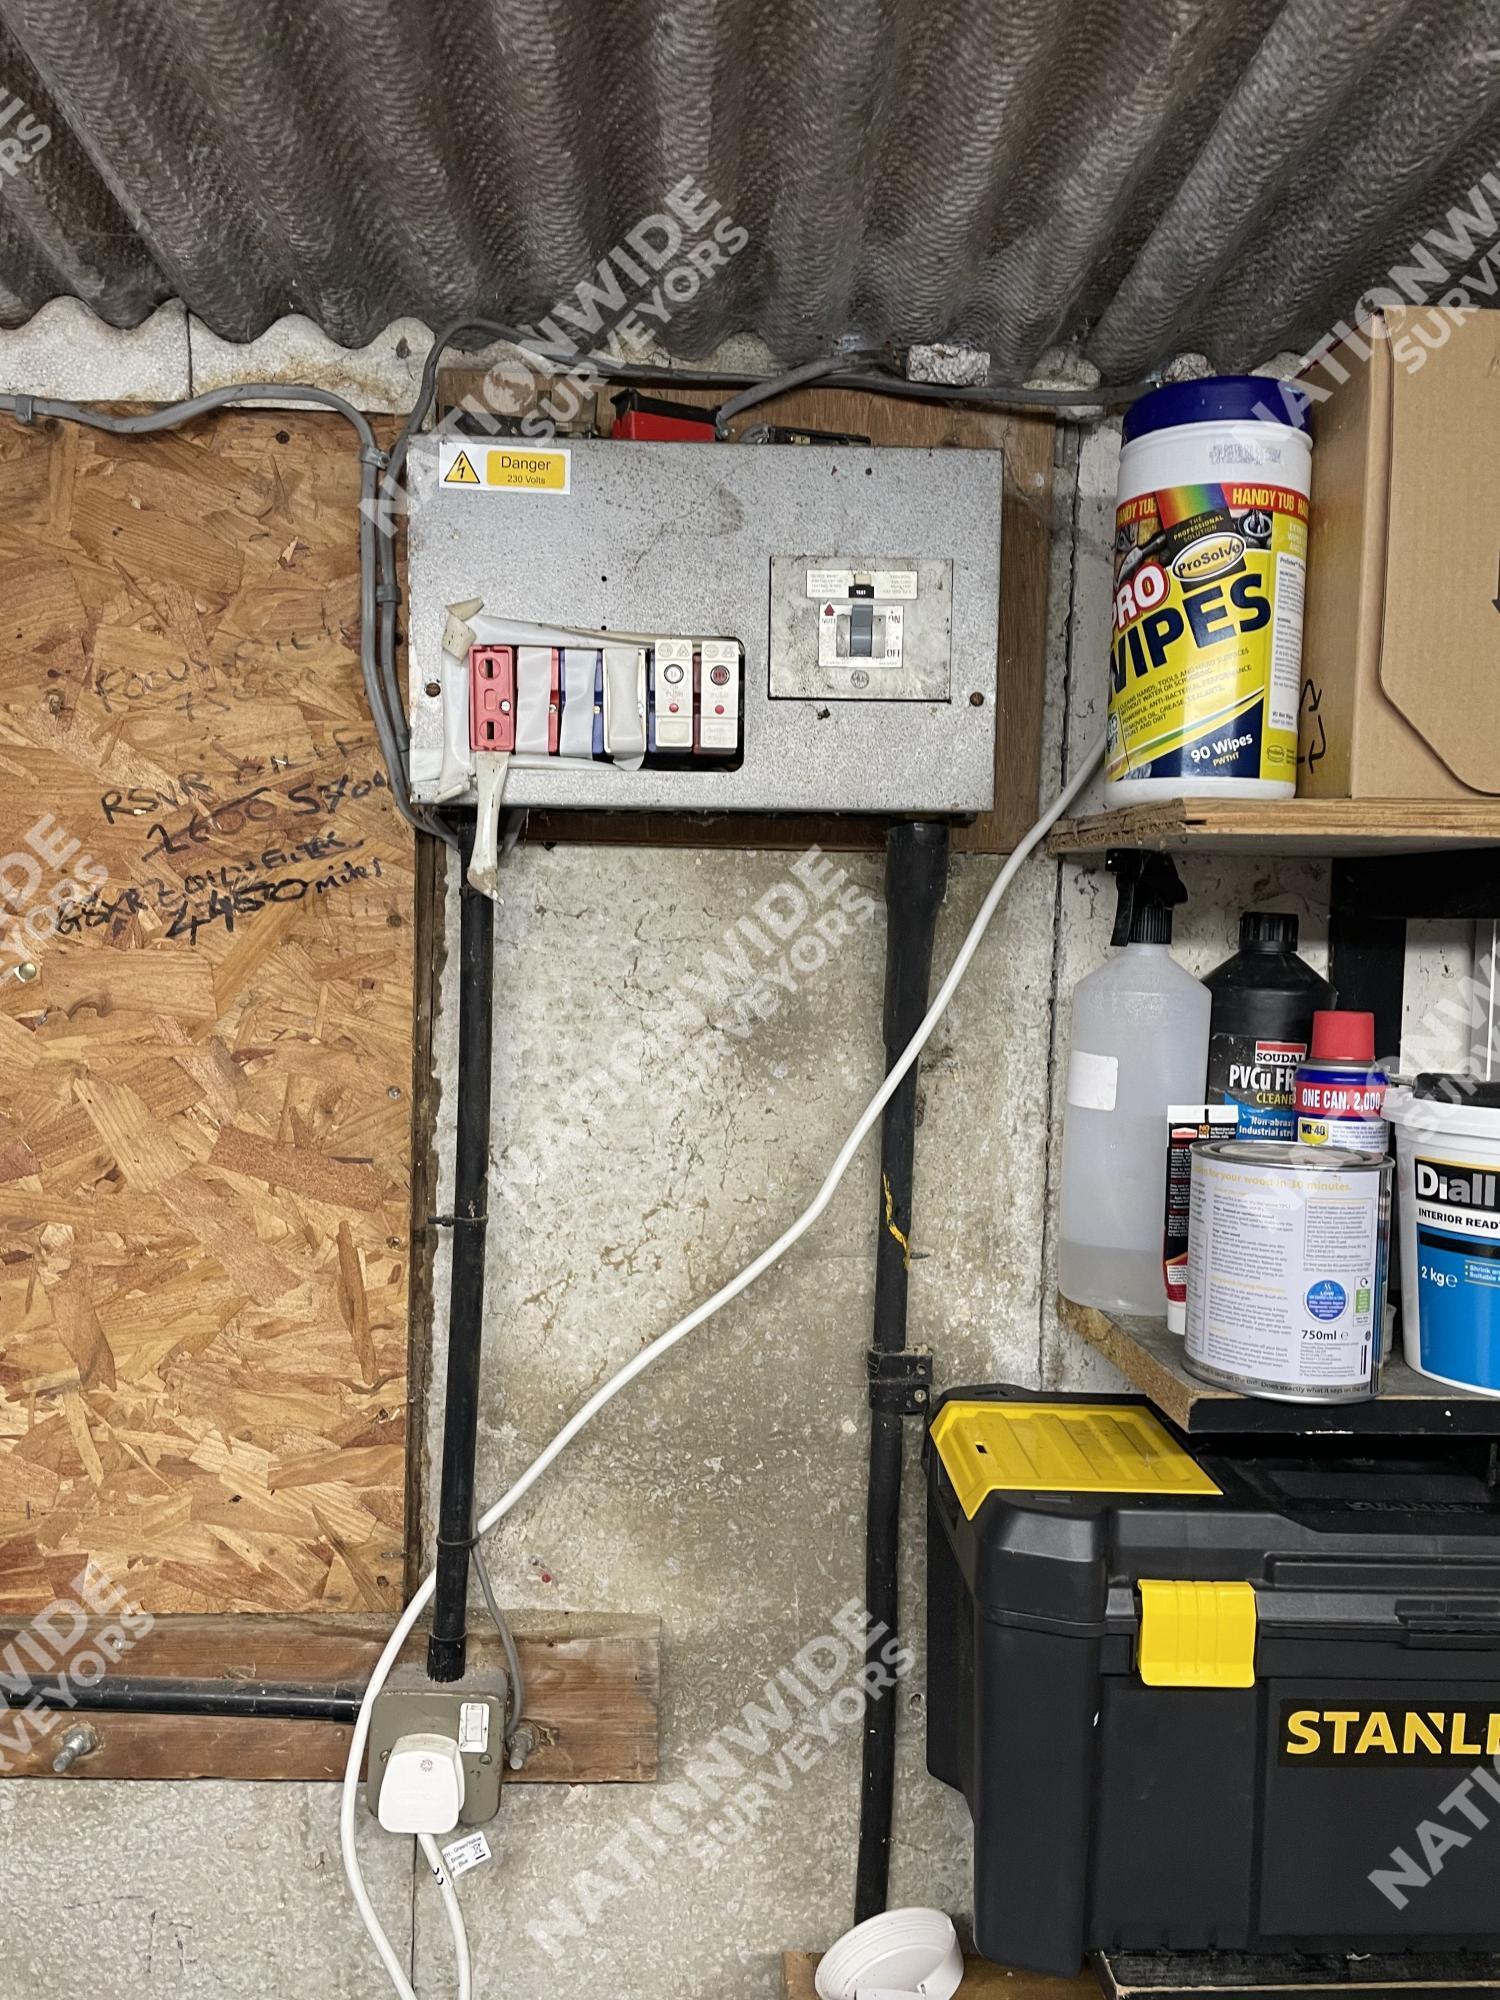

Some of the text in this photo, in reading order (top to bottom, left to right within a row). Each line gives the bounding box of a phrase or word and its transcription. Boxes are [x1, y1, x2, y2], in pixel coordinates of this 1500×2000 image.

[501, 456, 551, 473] Danger
[507, 474, 546, 485] 230 Volts
[1232, 488, 1276, 507] HANDY
[1279, 493, 1295, 511] TUB
[1174, 515, 1224, 540] PROFESSIONAL
[1183, 525, 1217, 543] SOLUTION
[1177, 538, 1241, 577] ProSolve
[888, 615, 901, 624] ON
[1159, 675, 1179, 687] TOOLS
[1143, 687, 1163, 703] WATER
[1164, 683, 1174, 693] OR
[1140, 720, 1152, 731] AND
[1153, 715, 1167, 726] DIRT
[1191, 733, 1253, 763] 90 Wipes
[1212, 752, 1240, 767] PWTHT
[1229, 1064, 1271, 1090] PVCu
[1302, 1088, 1320, 1107] ONE
[1324, 1090, 1350, 1110] CAN.
[1240, 1126, 1278, 1138] Industrial
[1302, 1123, 1325, 1136] WD-40
[1307, 1181, 1352, 1192] minutes.
[1417, 1164, 1496, 1207] Diall
[1418, 1207, 1500, 1230] INTERIOR READ
[1421, 1266, 1445, 1287] 2 kg
[1469, 1264, 1491, 1274] Shrink
[1301, 1329, 1337, 1341] 750ml
[1306, 1386, 1322, 1394] what
